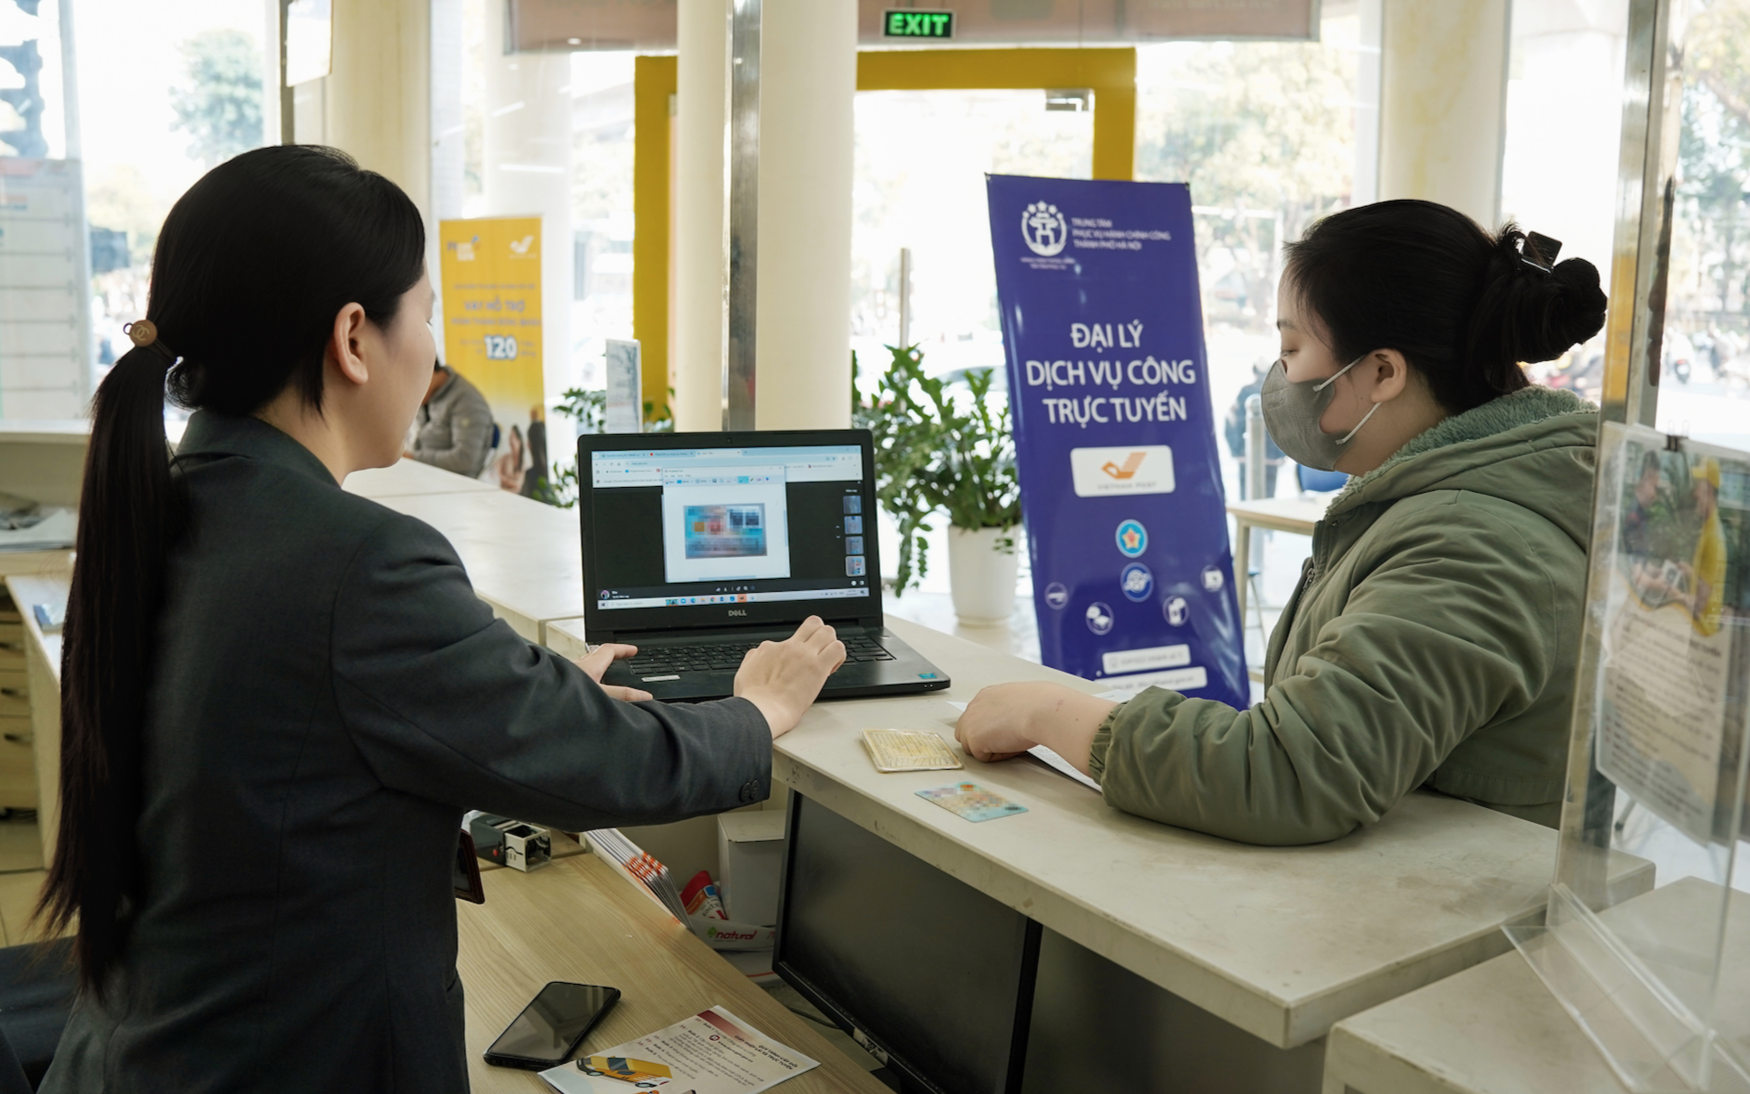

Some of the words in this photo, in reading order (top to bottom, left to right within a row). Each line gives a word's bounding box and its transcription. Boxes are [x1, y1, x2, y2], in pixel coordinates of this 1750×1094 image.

[888, 13, 949, 36] EXIT
[484, 334, 518, 361] 120
[1070, 323, 1114, 353] ĐẠI
[1118, 319, 1144, 348] LÝ
[1025, 360, 1086, 391] DỊCH
[1087, 360, 1123, 390] VỤ
[1127, 355, 1196, 385] CÔNG
[1042, 395, 1109, 429] TRỰC
[1109, 390, 1187, 423] TUYẾN
[716, 930, 757, 940] natural
